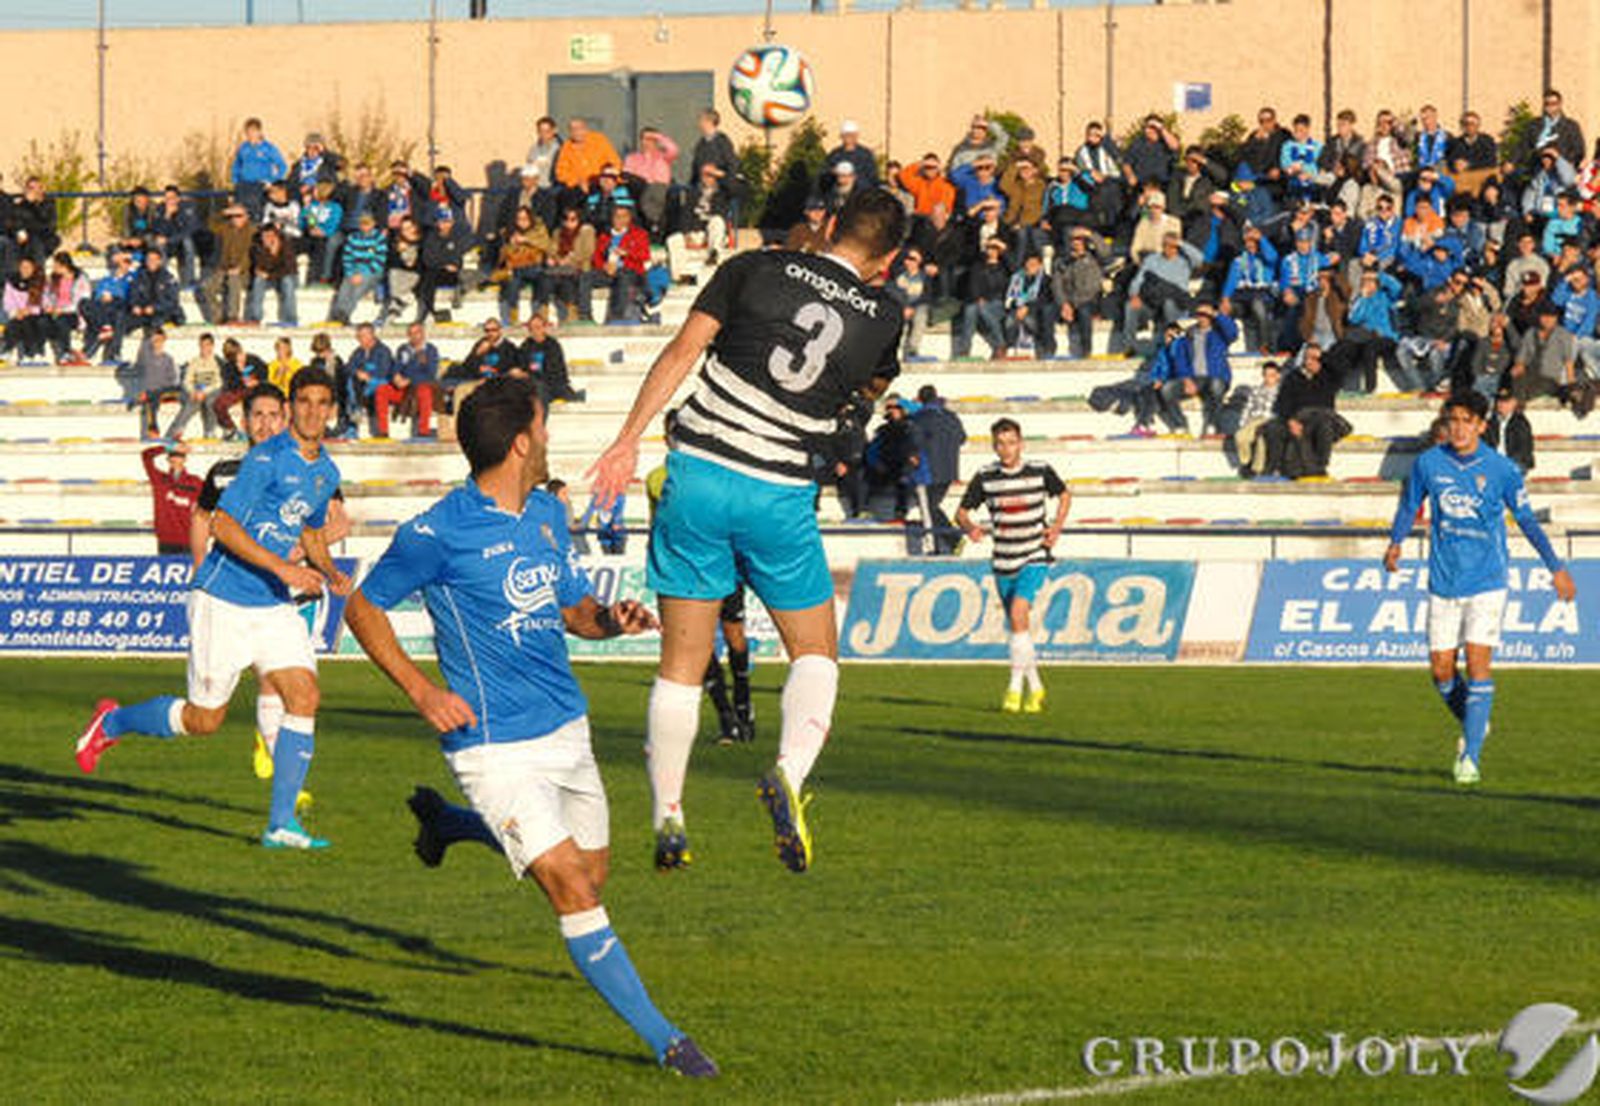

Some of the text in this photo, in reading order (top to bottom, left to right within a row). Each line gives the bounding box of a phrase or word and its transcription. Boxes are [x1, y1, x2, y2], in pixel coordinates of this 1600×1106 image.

[768, 302, 844, 393] 3
[90, 563, 134, 584] DE
[10, 610, 164, 628] 956 88 40 01
[1279, 600, 1353, 633] EL
[1298, 640, 1369, 657] Cascos
[1373, 640, 1429, 657] Azule
